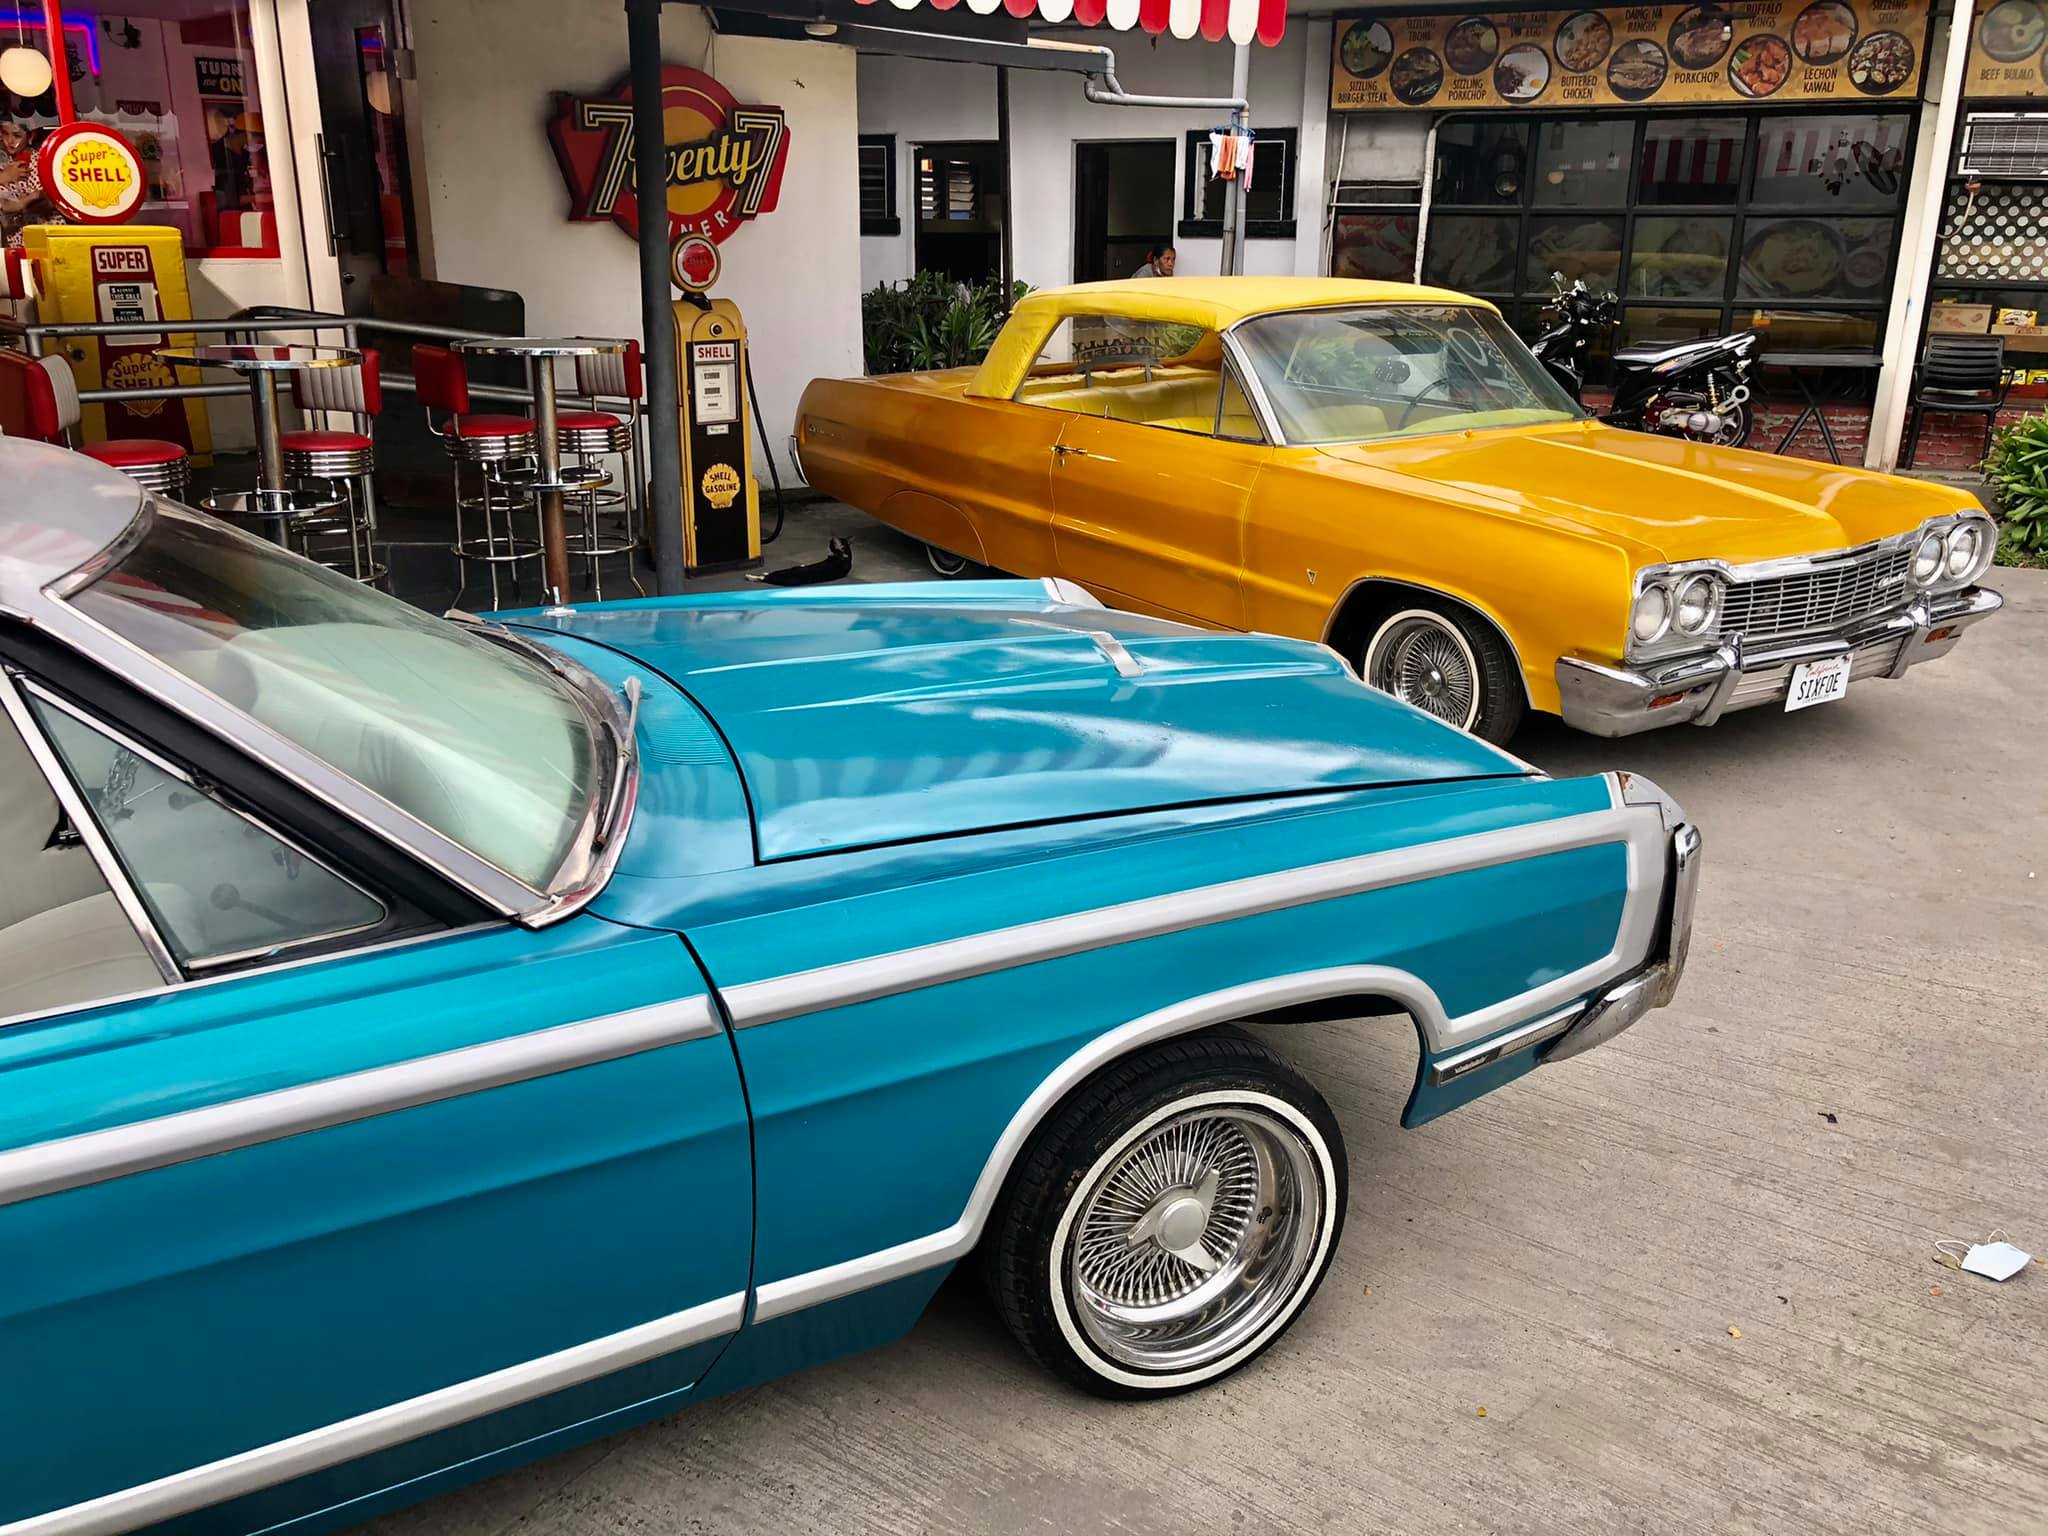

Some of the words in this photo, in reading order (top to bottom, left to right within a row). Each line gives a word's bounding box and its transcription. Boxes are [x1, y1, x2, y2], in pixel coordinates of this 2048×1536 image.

[199, 61, 243, 76] TURN
[1803, 68, 1838, 80] LECHON
[1980, 69, 2000, 80] BEEF
[1561, 75, 1598, 87] BUTTERED
[1674, 72, 1719, 83] PORKCHOP
[220, 77, 245, 93] ON
[1349, 81, 1377, 92] SIZZLING
[1453, 79, 1483, 90] SIZZLING
[1803, 82, 1835, 93] KAWALI
[1338, 92, 1365, 103] BURGER
[1448, 90, 1487, 101] PORKCHOP
[1563, 88, 1593, 99] CHICKEN
[68, 168, 126, 182] SHELL
[98, 251, 146, 269] SUPER
[698, 347, 732, 359] SHELL
[709, 472, 732, 484] SHELL
[705, 482, 737, 495] GASOLINE
[1797, 672, 1841, 701] SIXFOE
